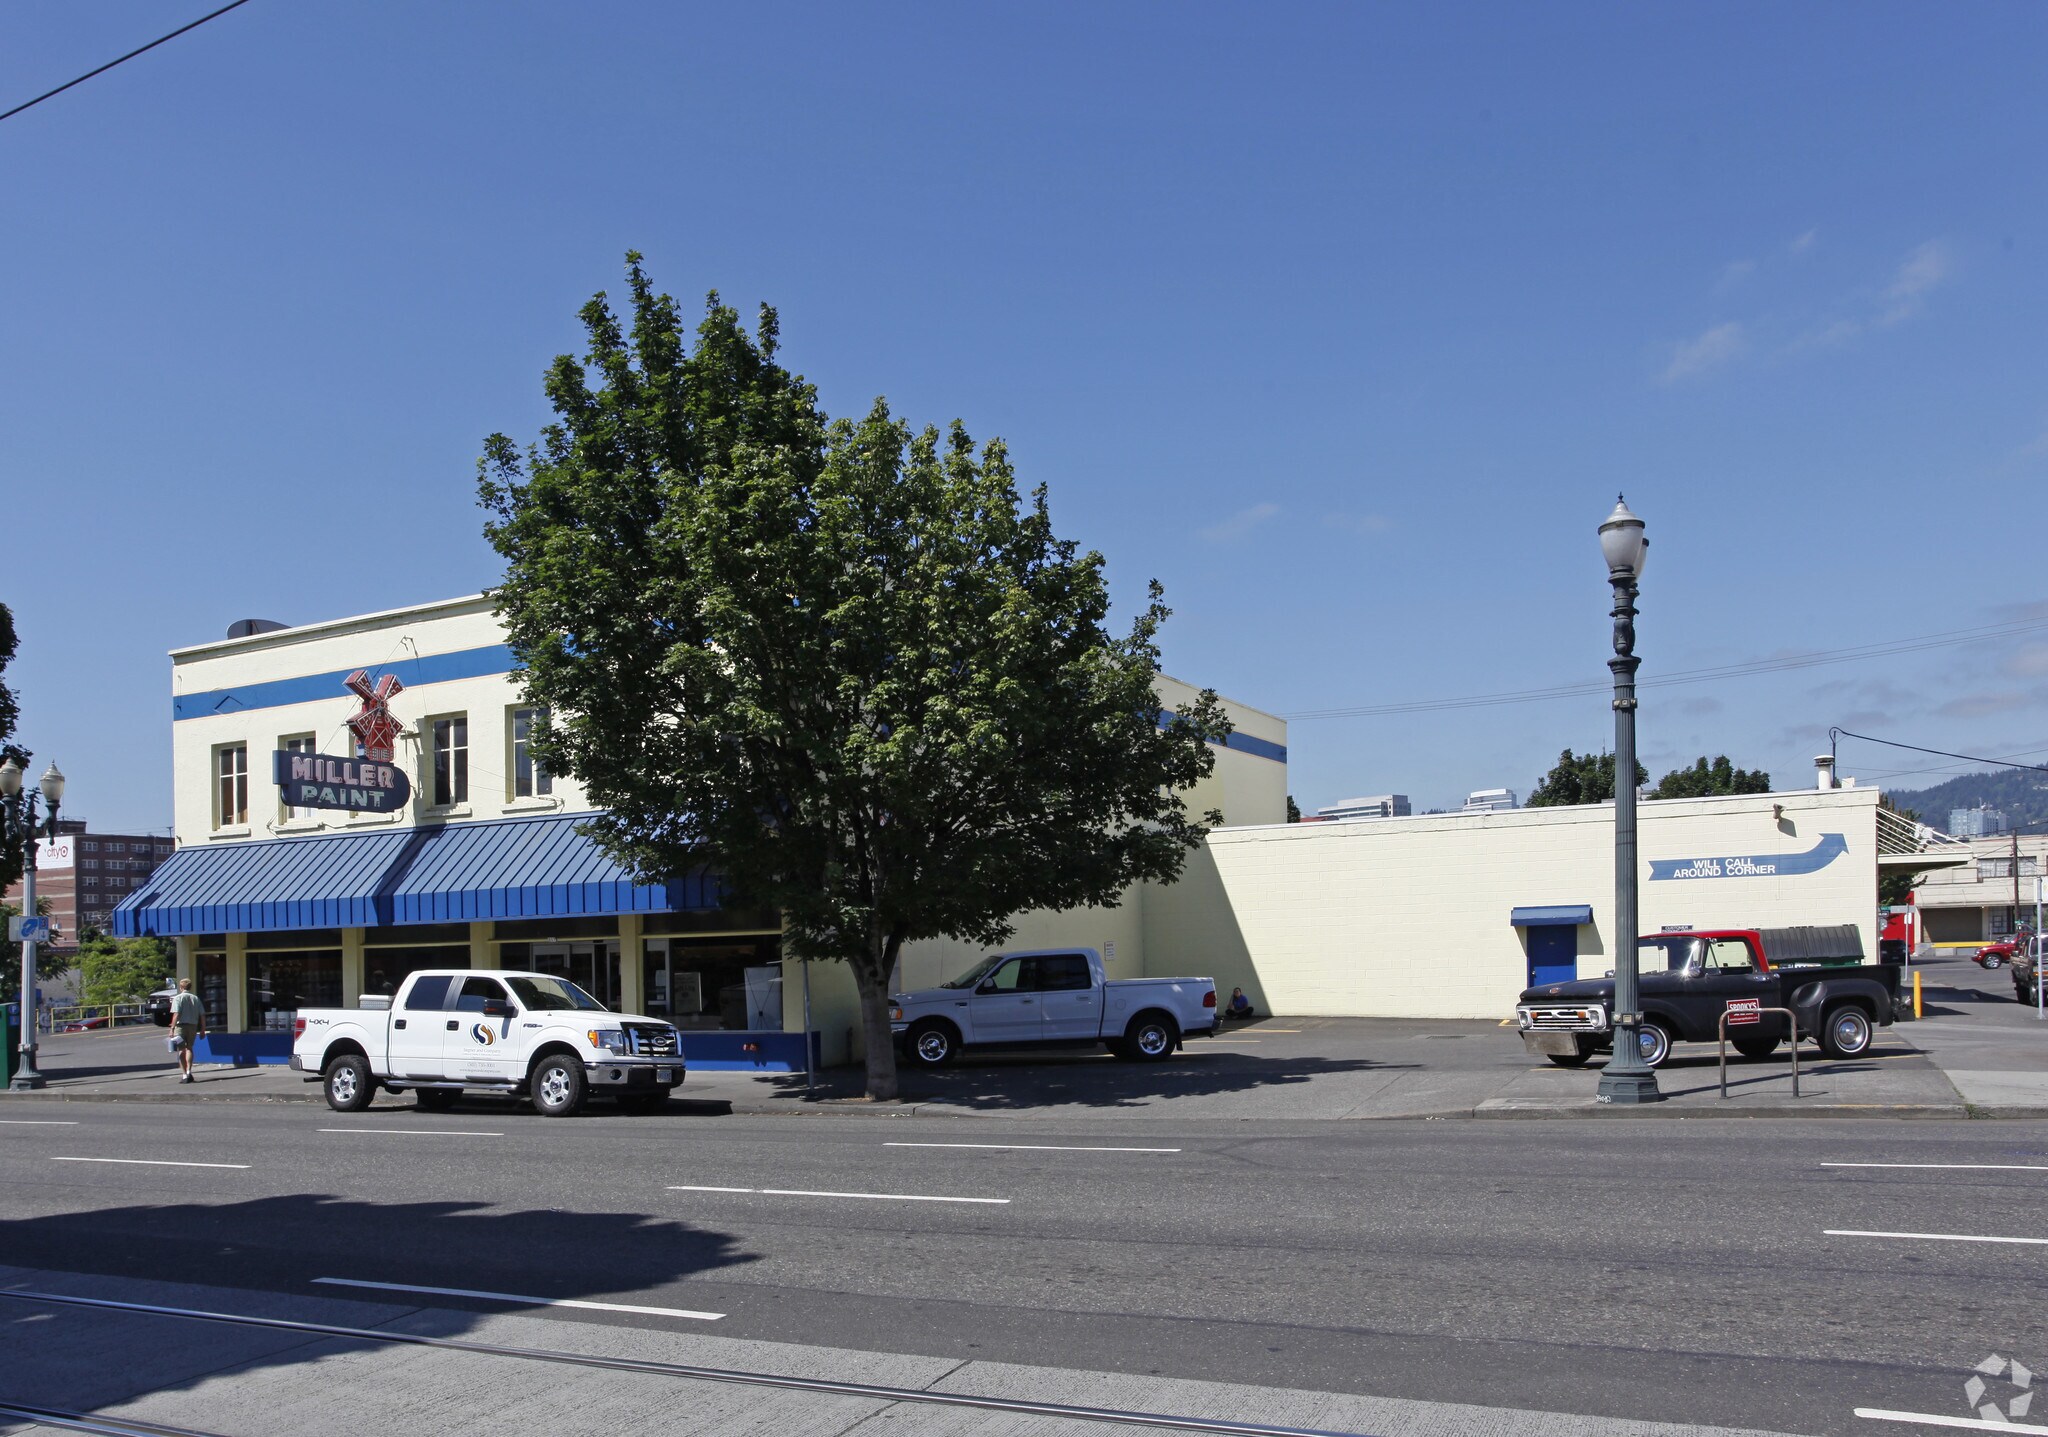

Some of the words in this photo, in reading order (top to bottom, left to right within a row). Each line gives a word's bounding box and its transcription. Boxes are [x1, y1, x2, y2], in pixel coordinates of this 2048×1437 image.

[292, 756, 395, 789] MILLER
[301, 785, 385, 808] PAINT
[1673, 867, 1721, 878] AROUND
[1726, 865, 1776, 876] CORNER
[1693, 859, 1720, 869] WILL
[1725, 858, 1755, 868] CALL
